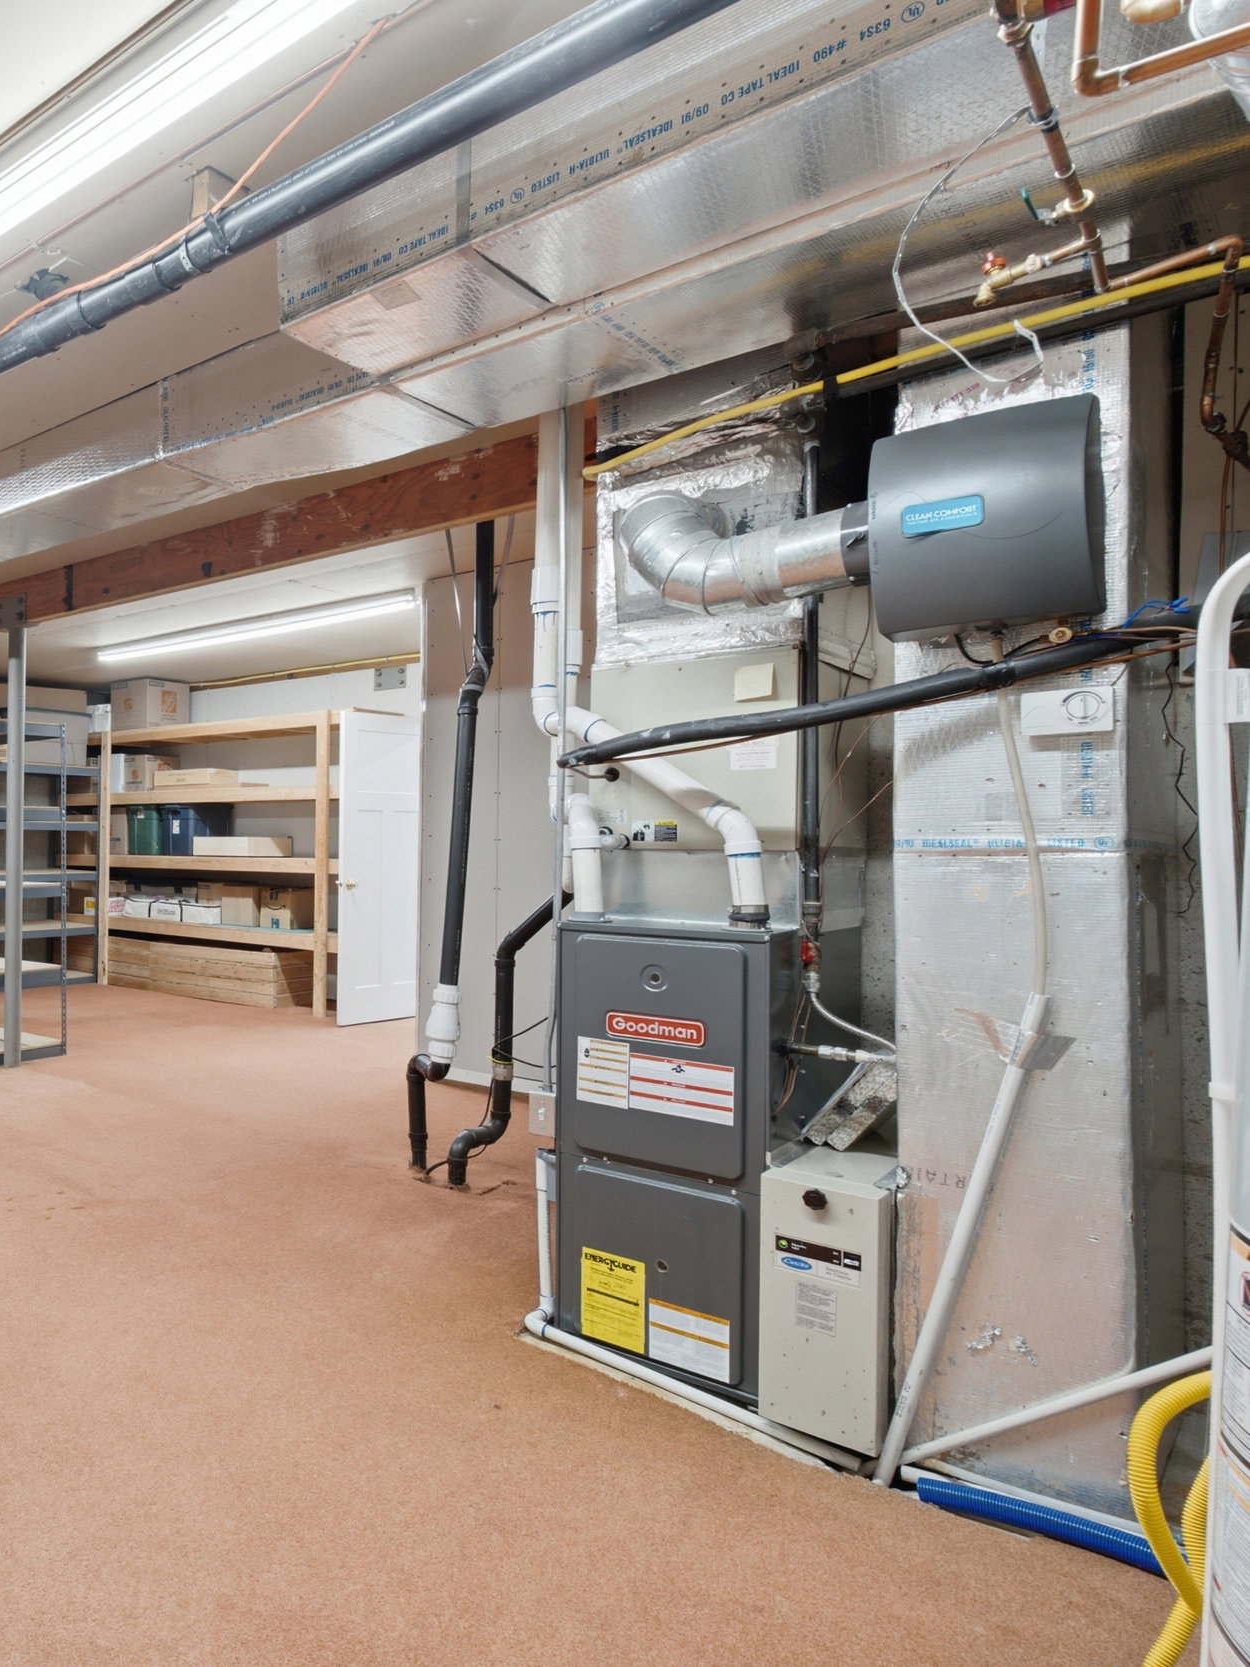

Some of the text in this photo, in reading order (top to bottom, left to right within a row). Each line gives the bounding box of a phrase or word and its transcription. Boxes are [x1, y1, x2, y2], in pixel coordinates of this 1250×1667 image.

[813, 39, 847, 63] #490
[766, 60, 800, 83] IDEAL
[738, 77, 764, 98] TAPE
[721, 91, 735, 106] CO
[681, 103, 710, 124] 09/91
[531, 171, 560, 193] LISTED
[905, 504, 977, 522] CLEAN COMFORT
[612, 1017, 697, 1040] Goodman
